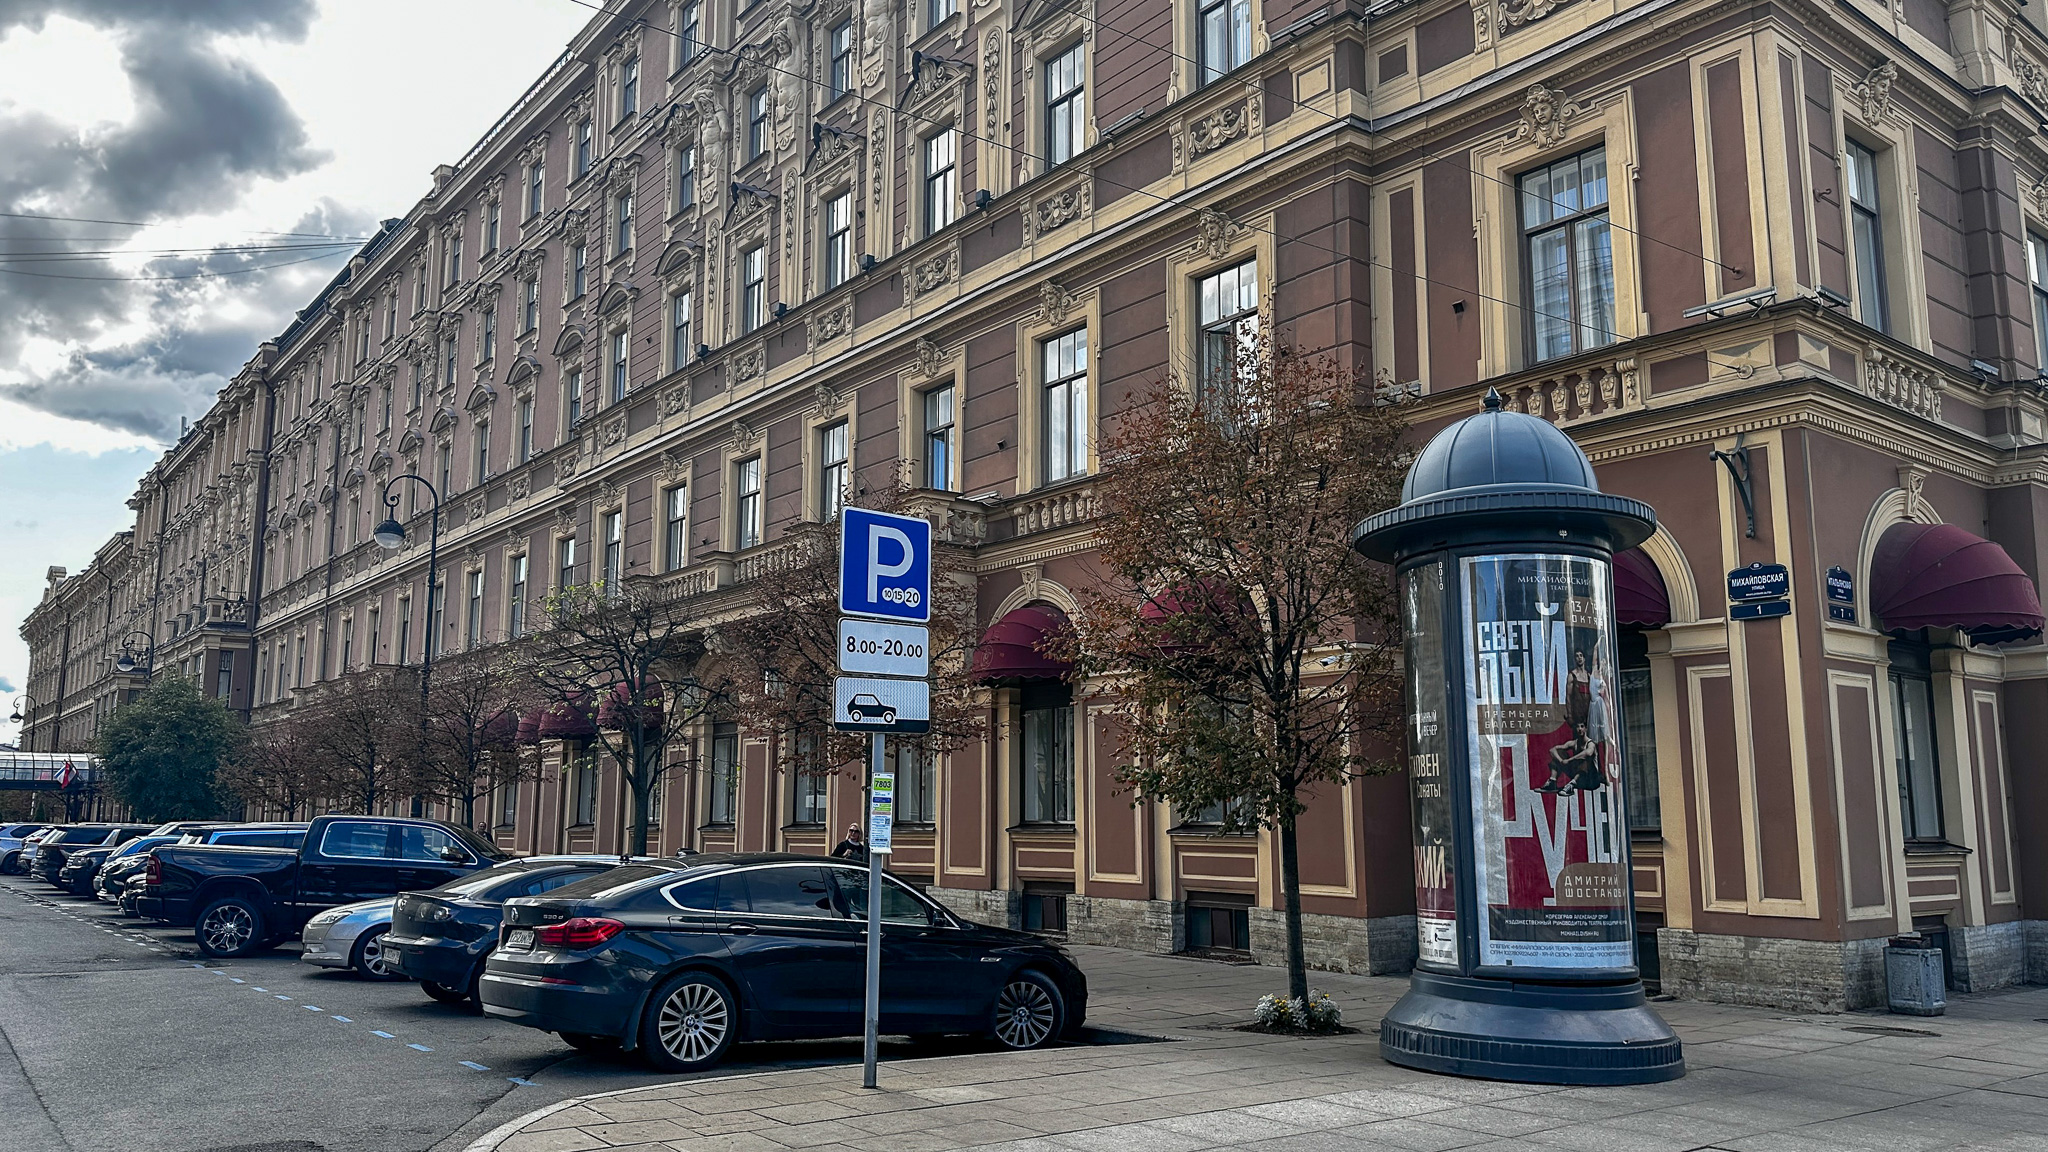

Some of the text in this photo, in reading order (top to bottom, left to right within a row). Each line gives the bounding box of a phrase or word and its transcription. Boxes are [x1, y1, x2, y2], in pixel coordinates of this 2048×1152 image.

[867, 523, 914, 603] P
[1731, 572, 1784, 587] МИХАЙЛОВСКАЯ
[884, 589, 919, 604] 10 15 20
[1571, 600, 1582, 612] 13
[1756, 604, 1762, 615] 1
[846, 636, 923, 658] 8.00-20.00
[1484, 710, 1549, 718] ПРЕМЬЕРА
[1484, 720, 1532, 729] БАЛЕТА
[874, 780, 892, 788] 7803
[1564, 874, 1618, 887] ДМИТРИЙ
